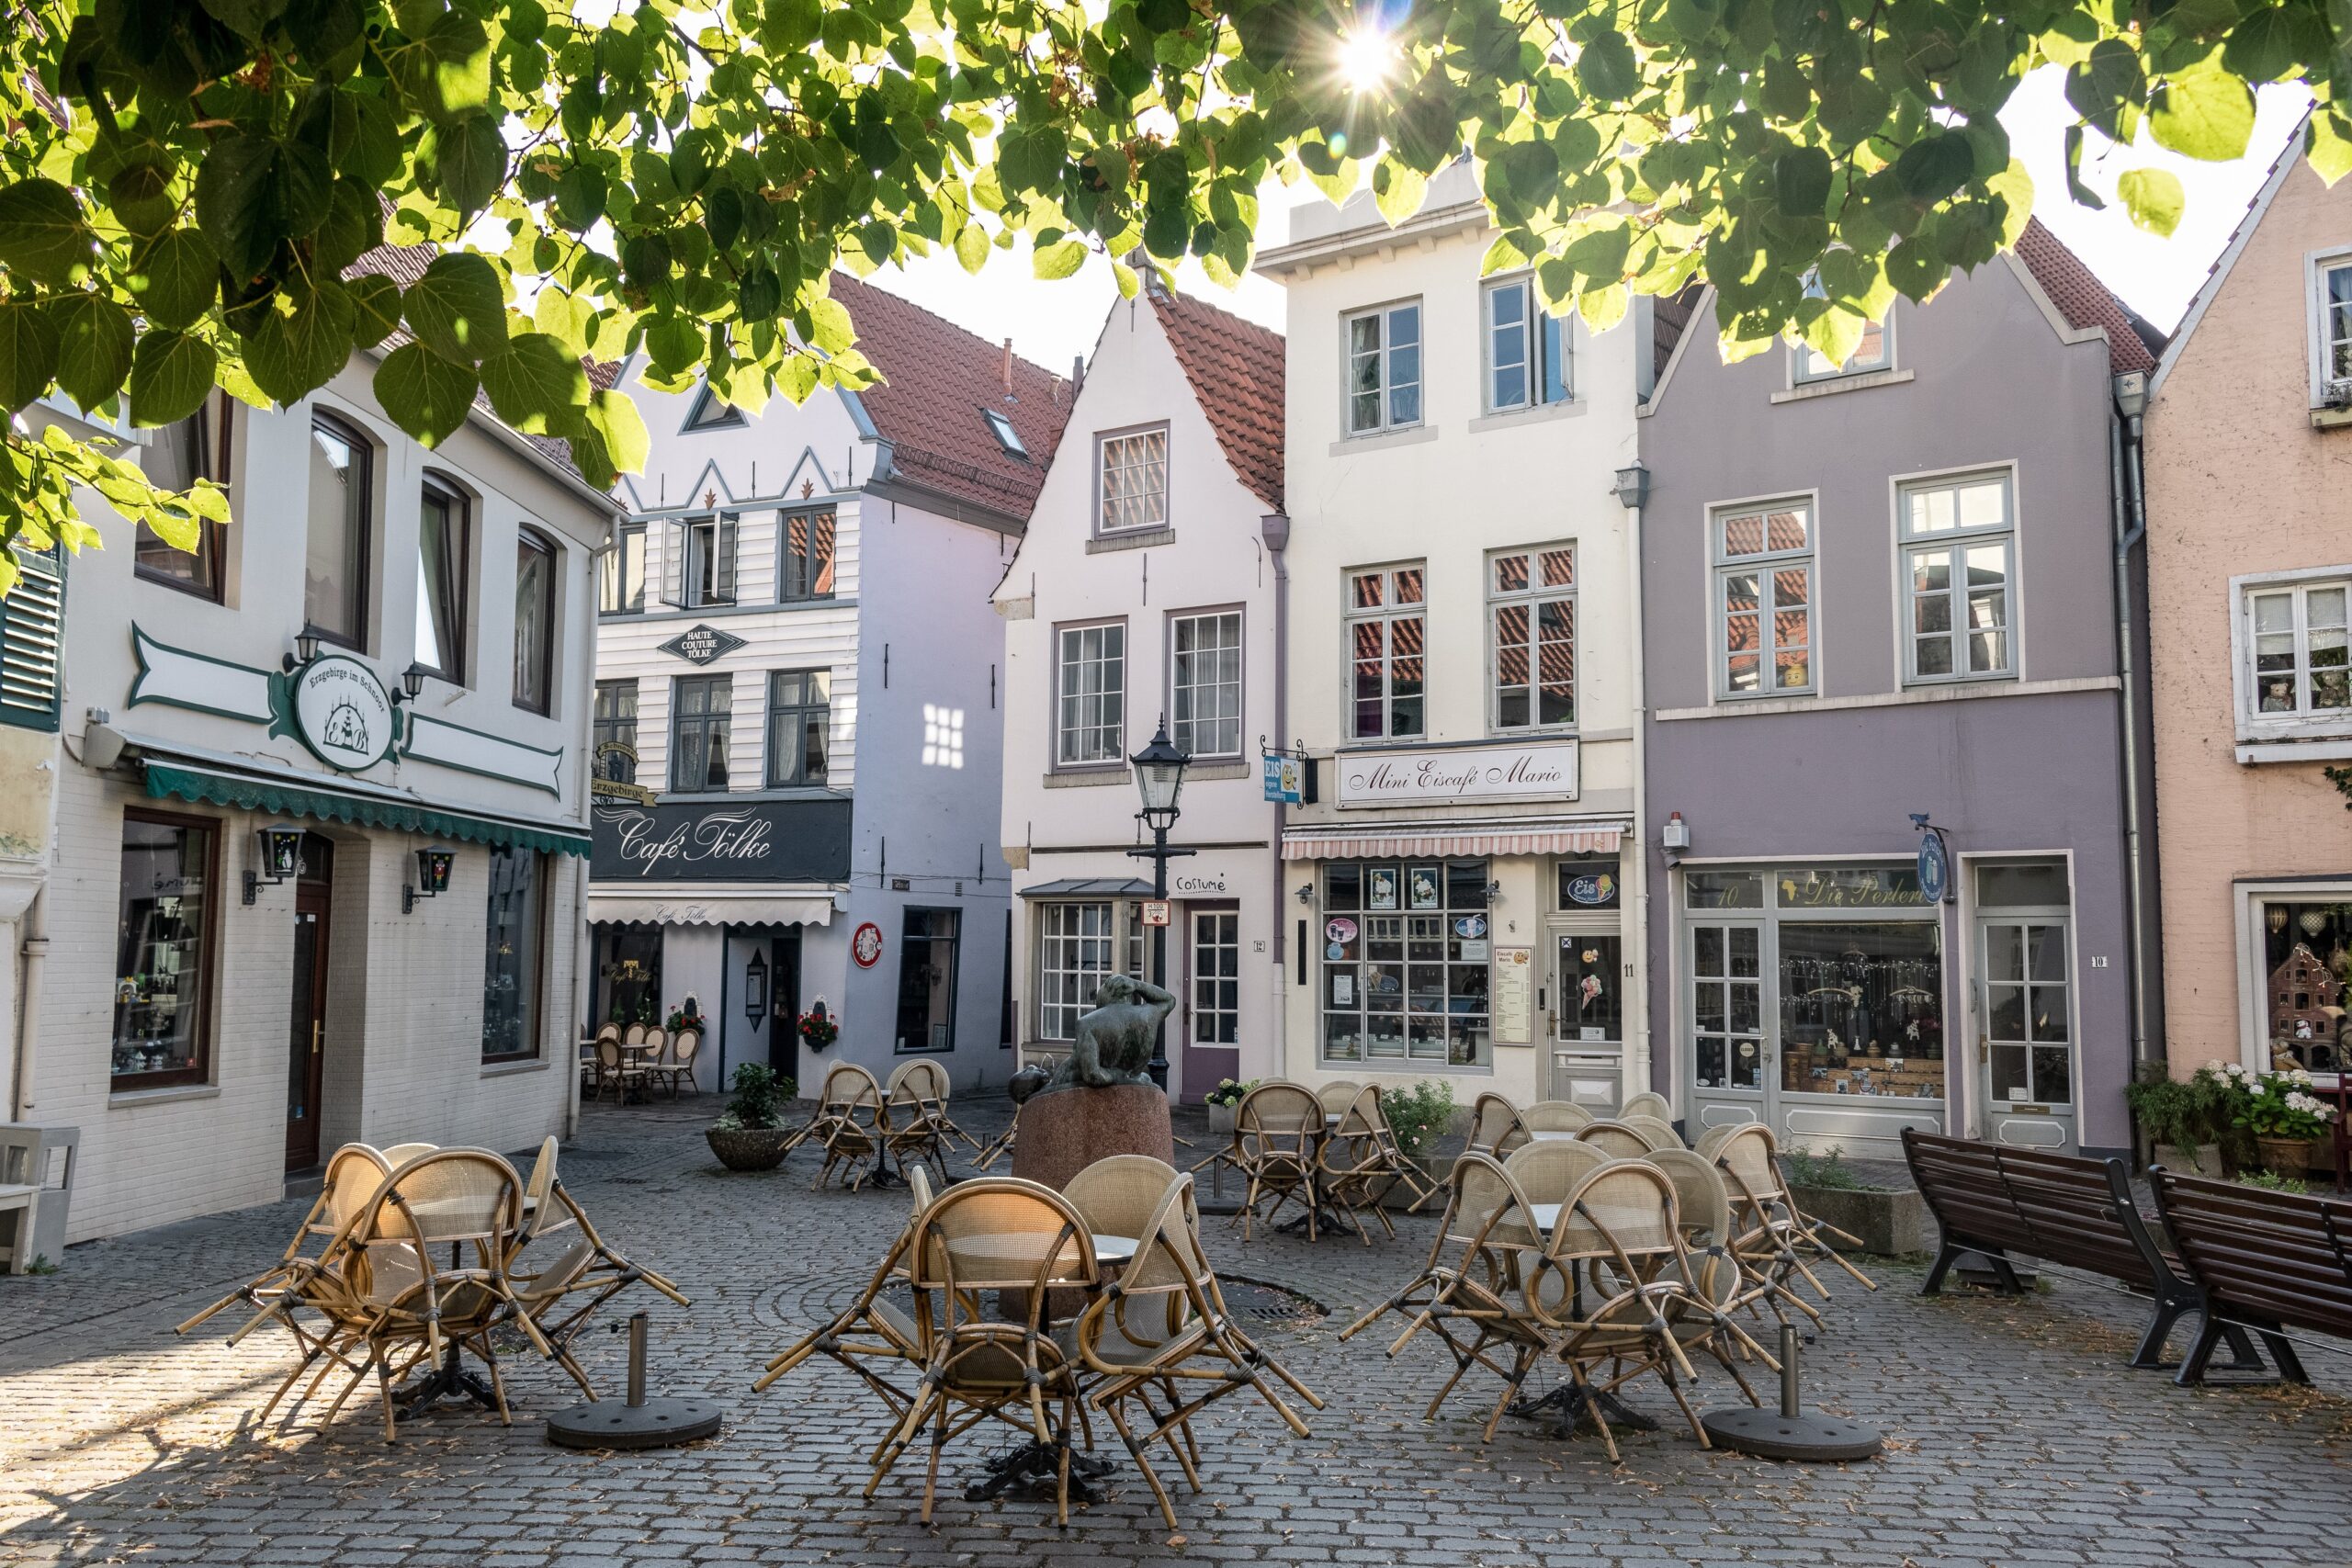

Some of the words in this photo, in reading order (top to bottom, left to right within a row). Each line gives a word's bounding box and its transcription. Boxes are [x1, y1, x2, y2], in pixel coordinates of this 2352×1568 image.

[687, 631, 712, 640] HAUTE
[681, 639, 718, 650] COUTURE
[686, 648, 712, 659] TÖLKE
[309, 667, 348, 689] Erzgebirge
[349, 669, 358, 682] im
[359, 676, 385, 713] Schnoor
[1264, 760, 1281, 779] EIS
[1348, 762, 1411, 791] Mini
[1416, 760, 1478, 795] Eiscafé
[1486, 755, 1564, 784] Mario
[591, 778, 644, 799] Erzgebirge
[594, 808, 690, 875] Café
[683, 807, 773, 862] Tölke
[1574, 879, 1596, 895] Eis
[1804, 875, 1844, 905] Die
[1717, 885, 1739, 907] 10
[1255, 942, 1263, 951] 12
[2094, 955, 2104, 967] 10
[1623, 964, 1634, 977] 11
